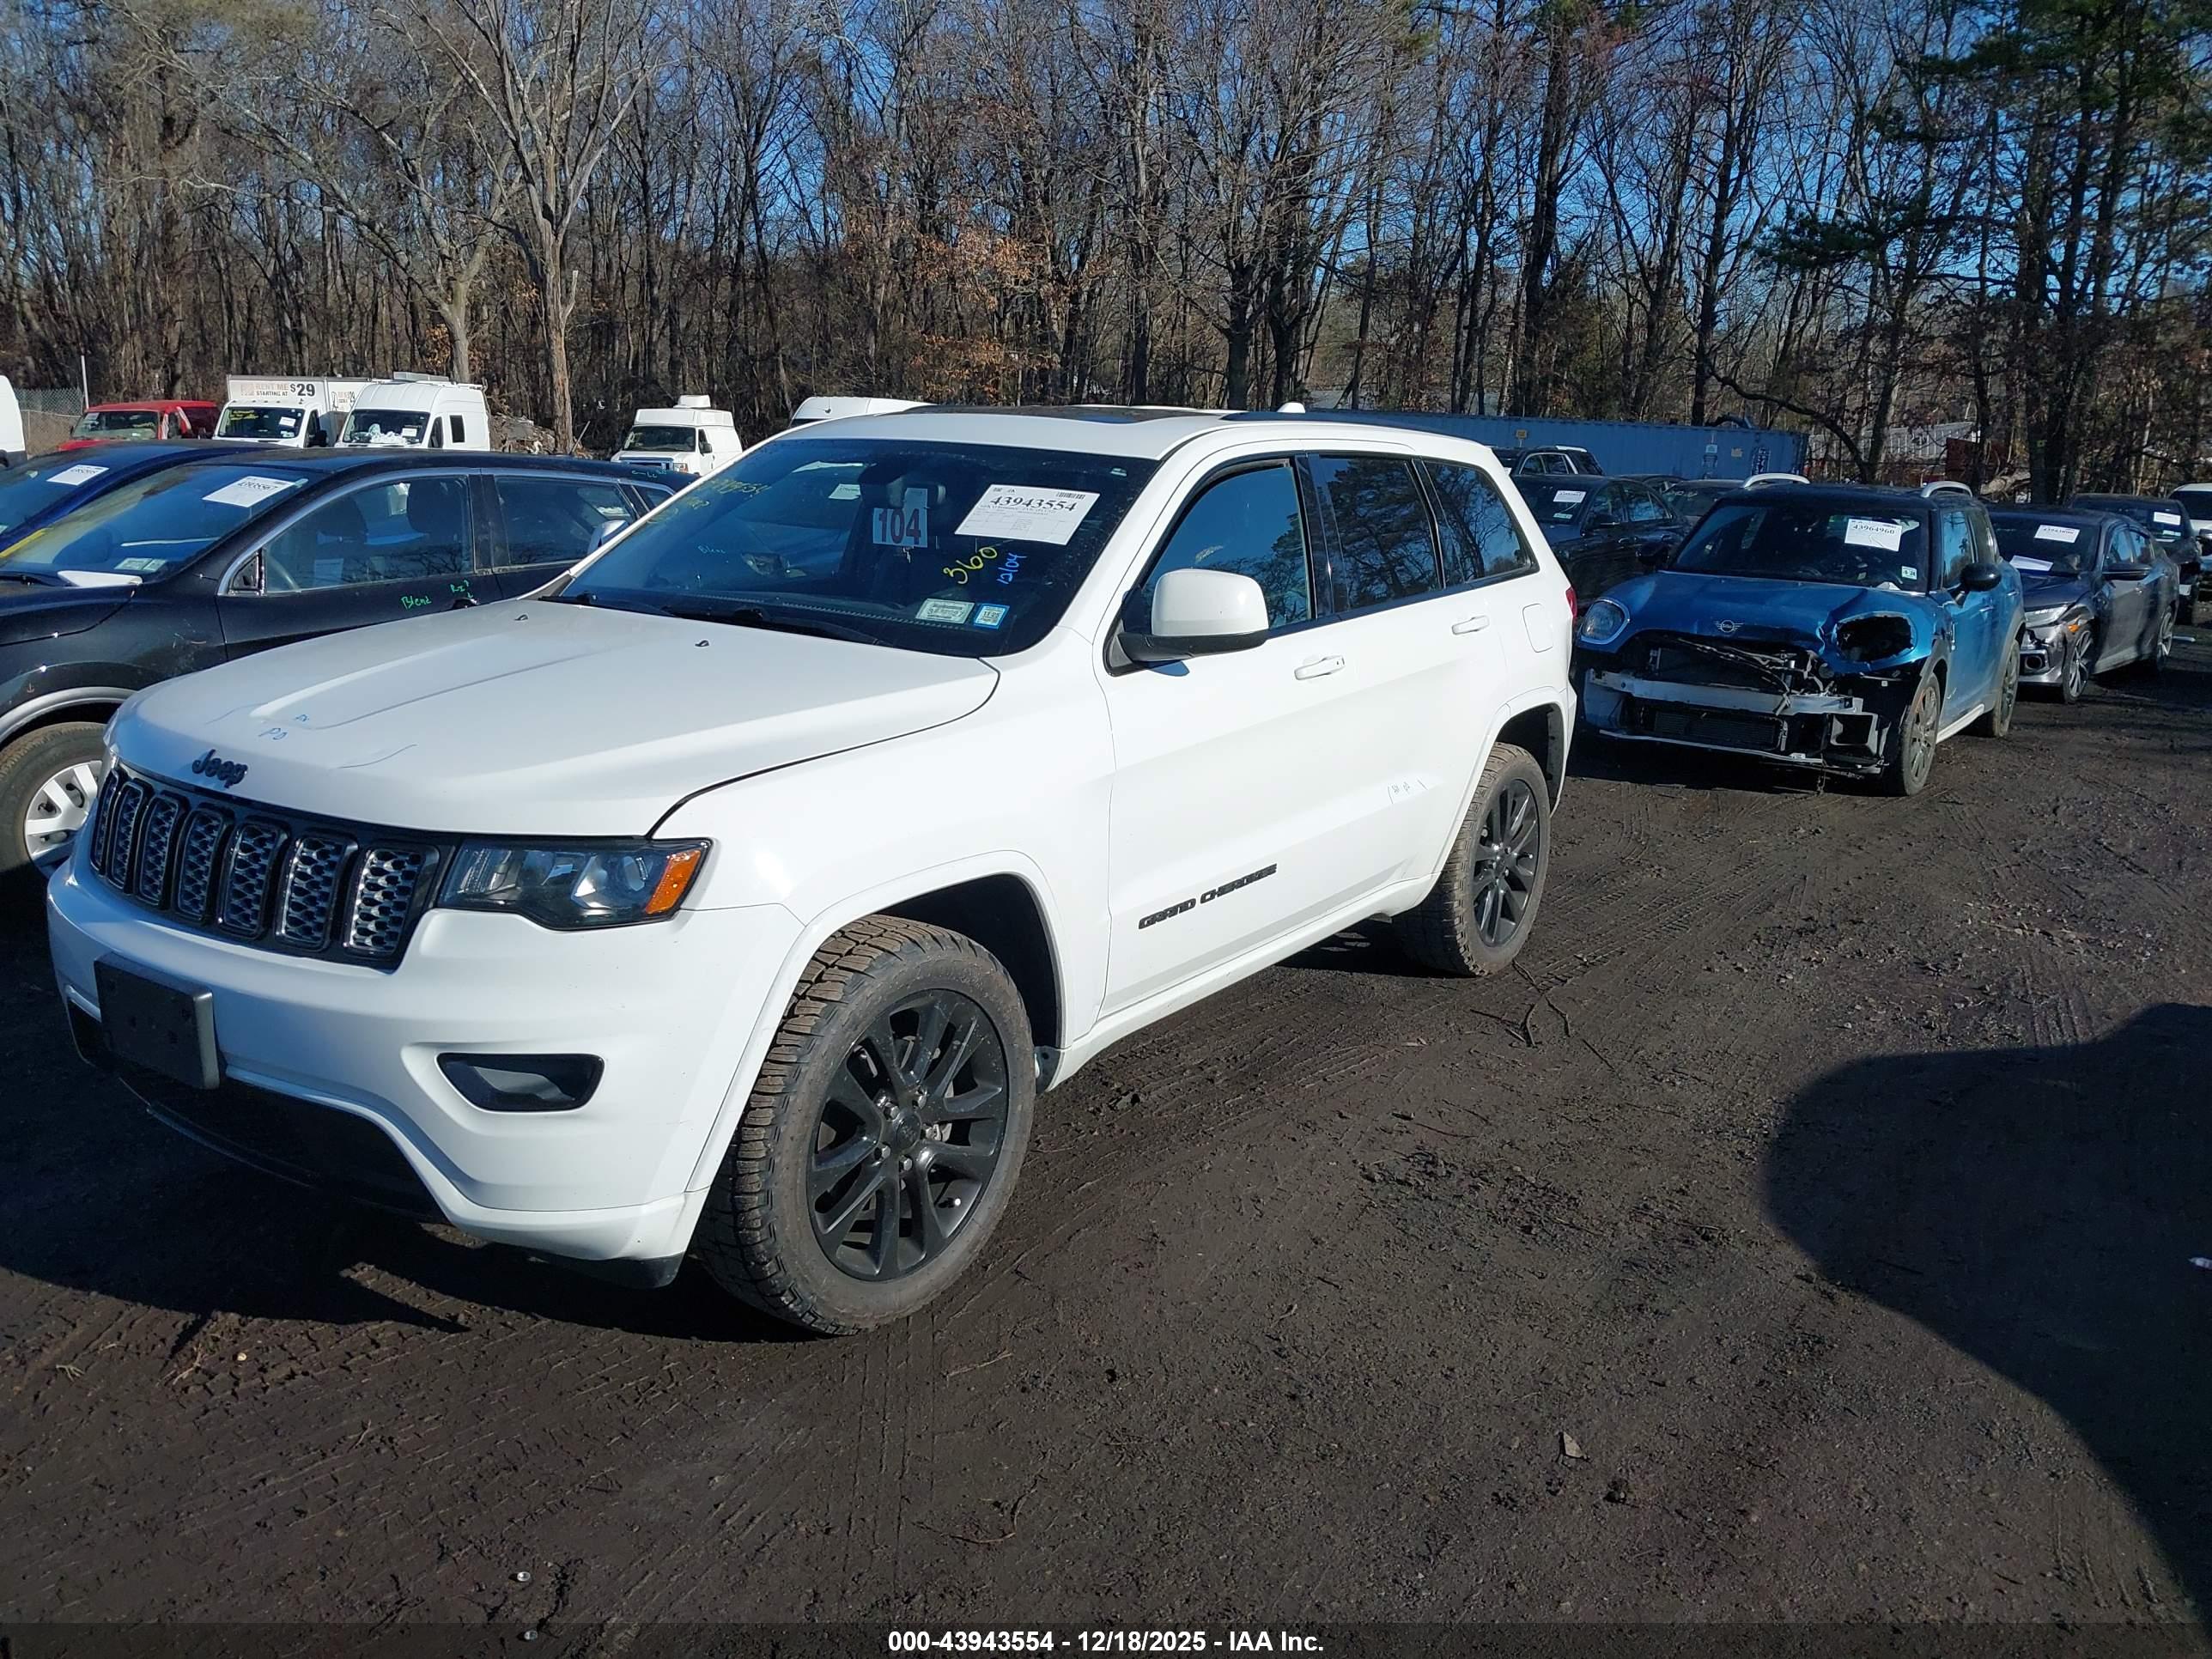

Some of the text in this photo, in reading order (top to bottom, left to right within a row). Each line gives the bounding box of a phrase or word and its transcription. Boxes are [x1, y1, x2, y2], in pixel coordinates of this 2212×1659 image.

[290, 383, 315, 397] $29
[990, 495, 1078, 512] 43943554
[878, 508, 921, 545] 104
[943, 546, 998, 584] 360
[192, 749, 249, 789] Jeep
[1139, 863, 1278, 930] GRAND CHEROKEE
